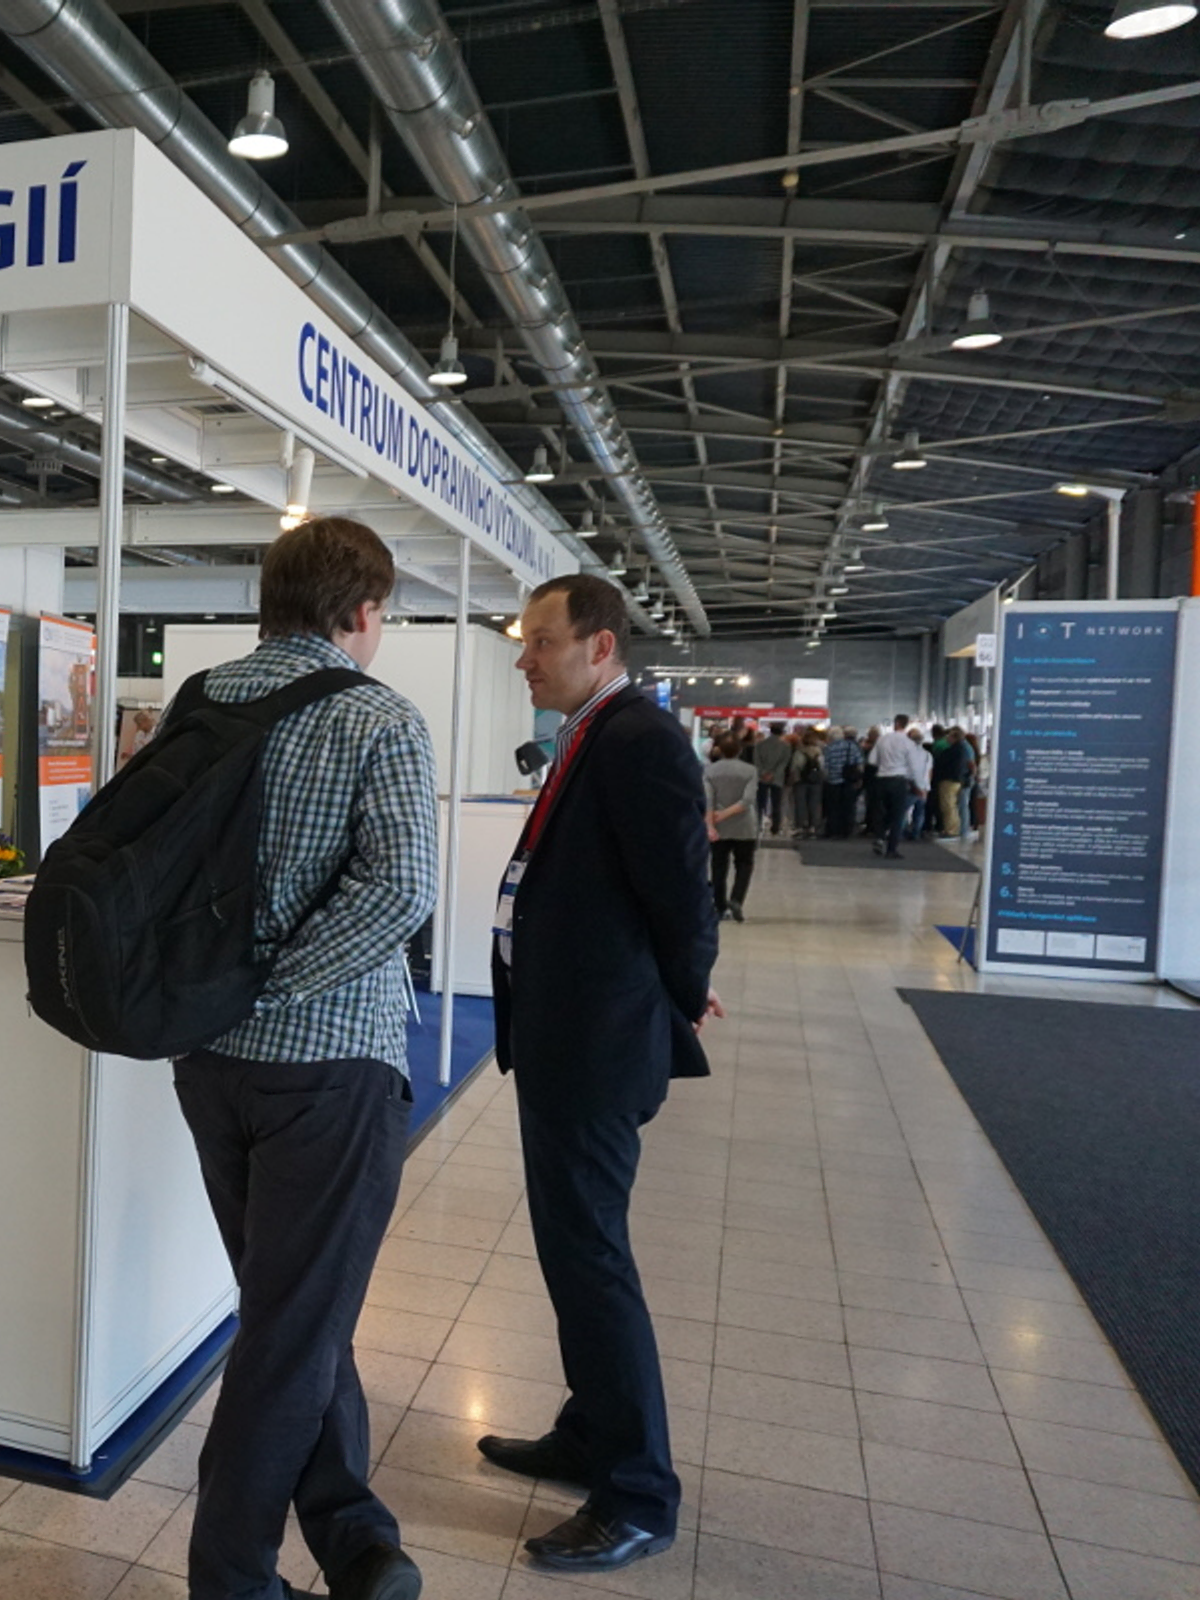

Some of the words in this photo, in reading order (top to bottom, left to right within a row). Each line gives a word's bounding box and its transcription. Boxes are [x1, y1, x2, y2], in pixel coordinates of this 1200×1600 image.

[298, 321, 403, 470] CENTRUM
[407, 414, 493, 535] DOPRAVNÍHO
[1085, 626, 1165, 637] NETWORK
